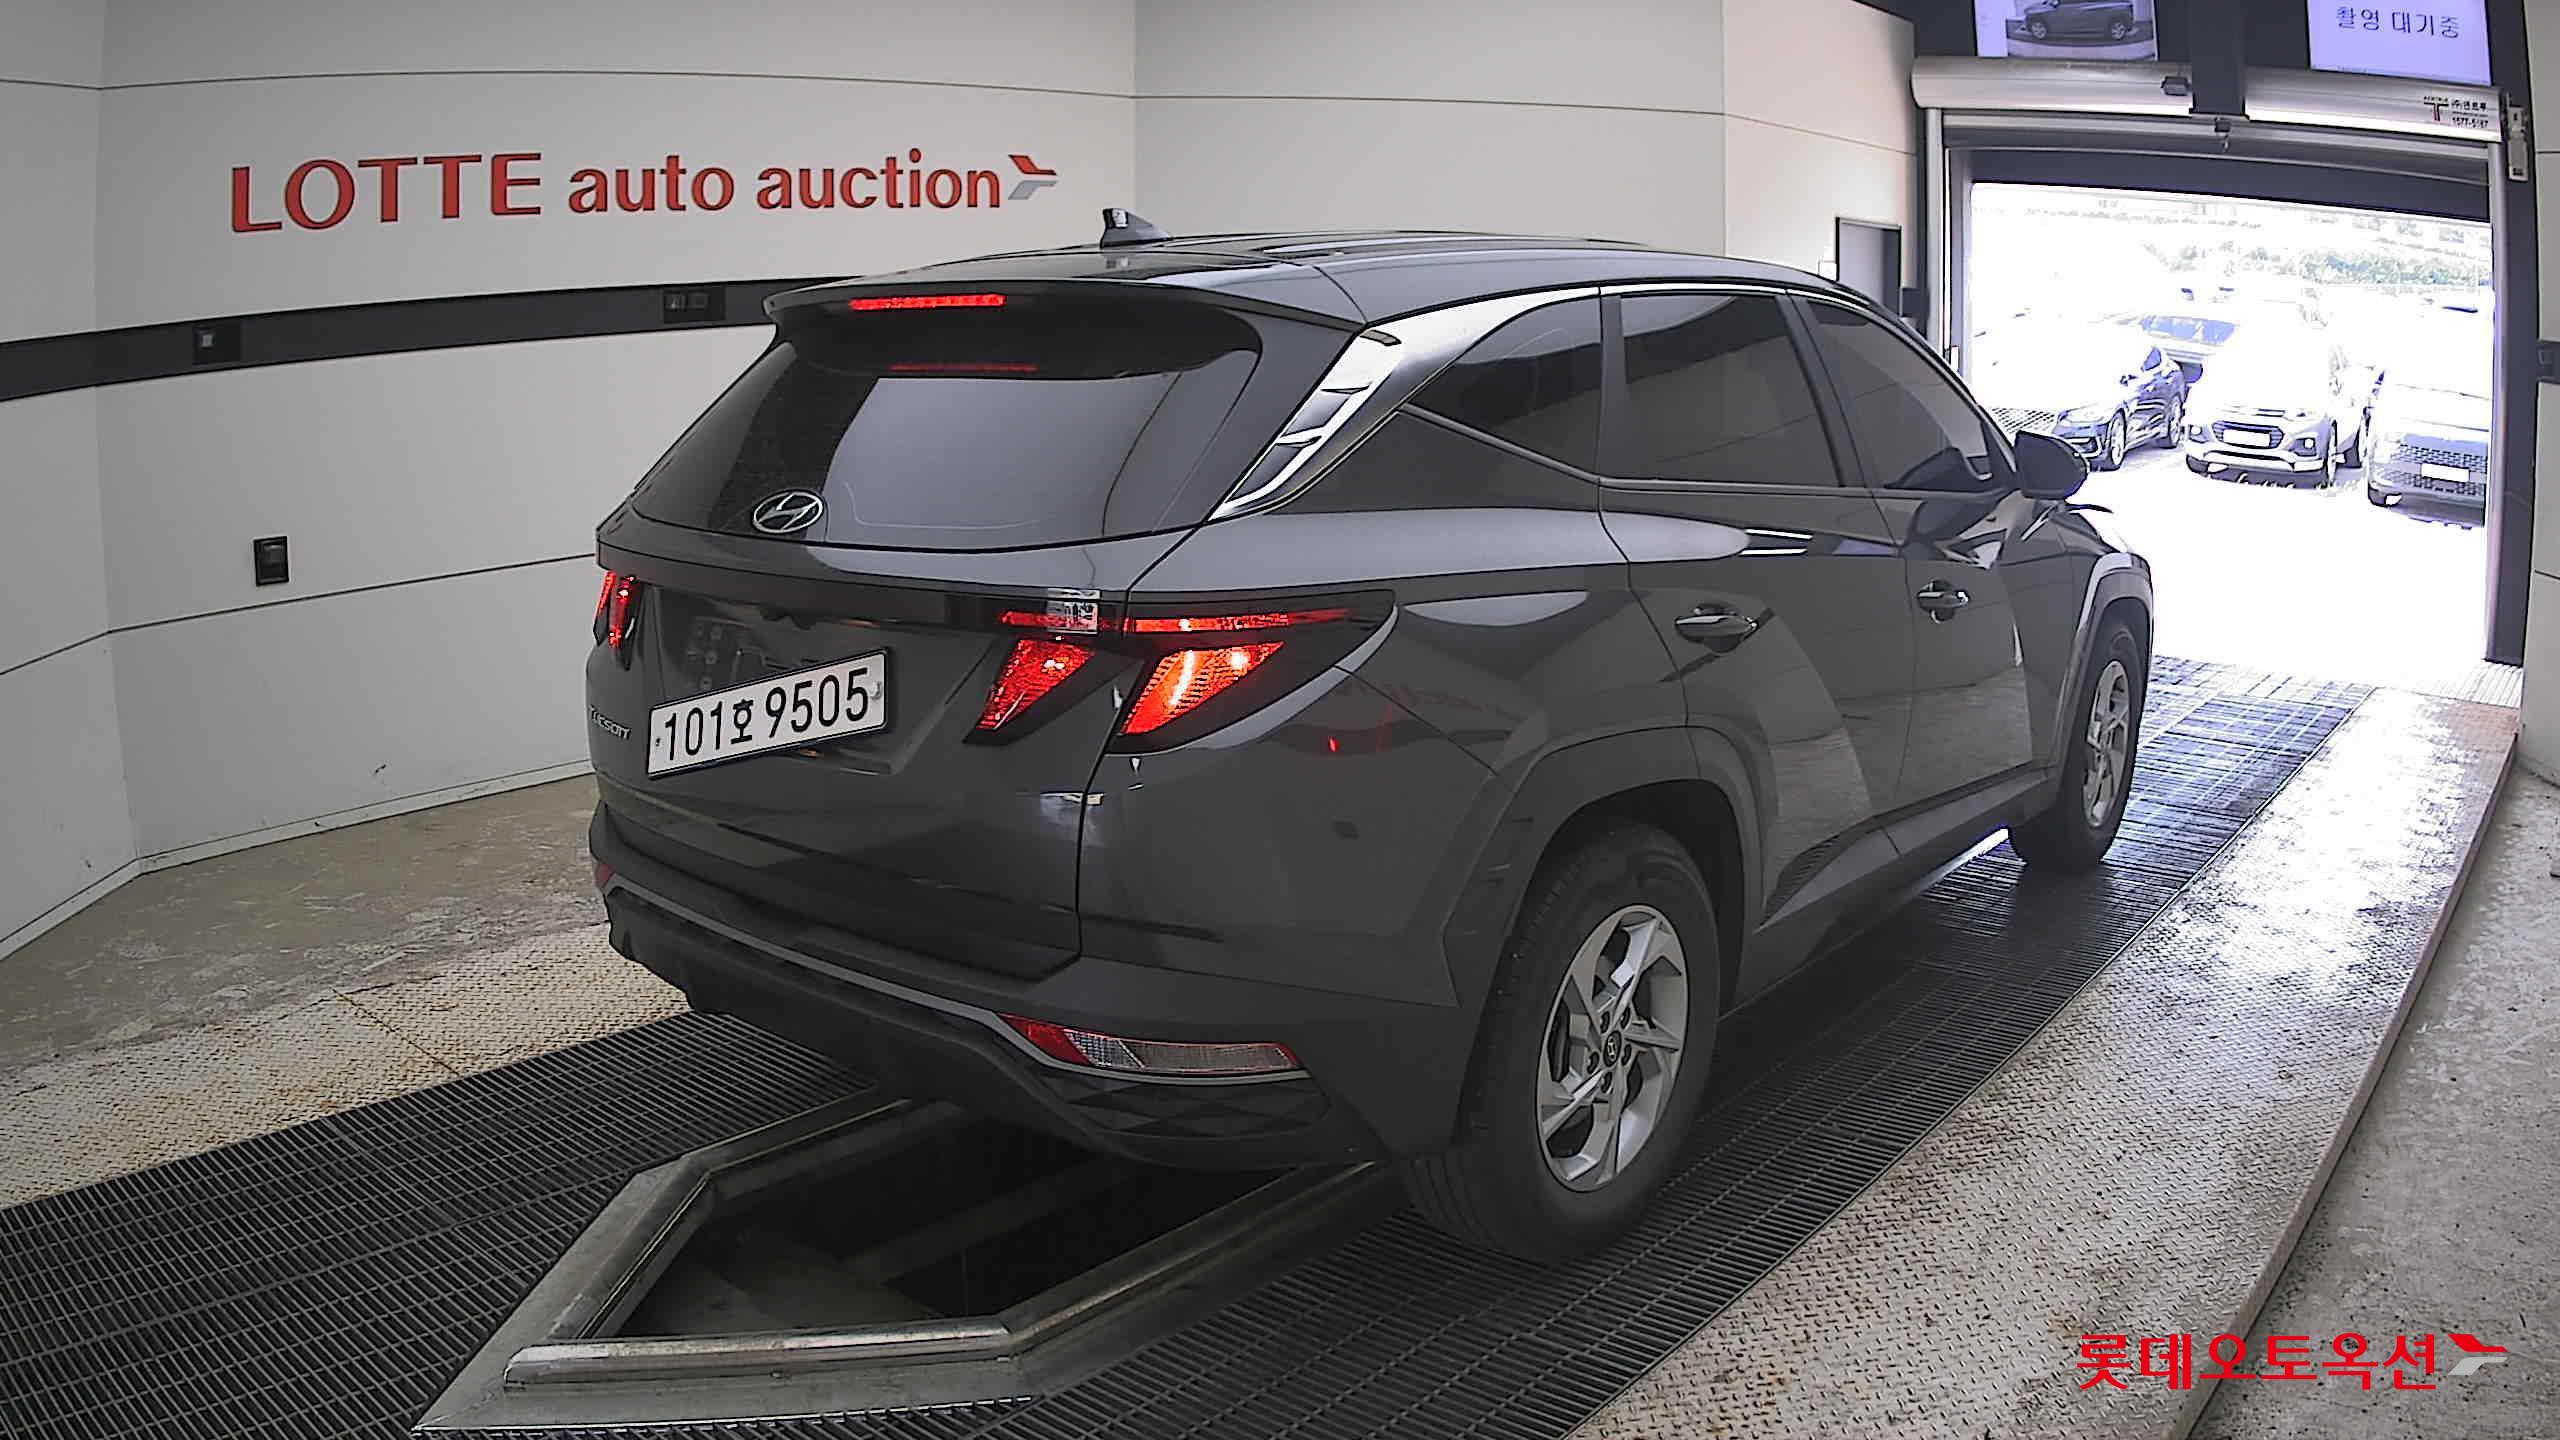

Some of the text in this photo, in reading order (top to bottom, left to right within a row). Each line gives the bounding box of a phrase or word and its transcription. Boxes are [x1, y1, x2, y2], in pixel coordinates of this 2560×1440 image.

[2336, 6, 2460, 39] 촬영 대기중
[231, 149, 1001, 232] LOTTE auto auction
[664, 666, 869, 761] 101호 9505
